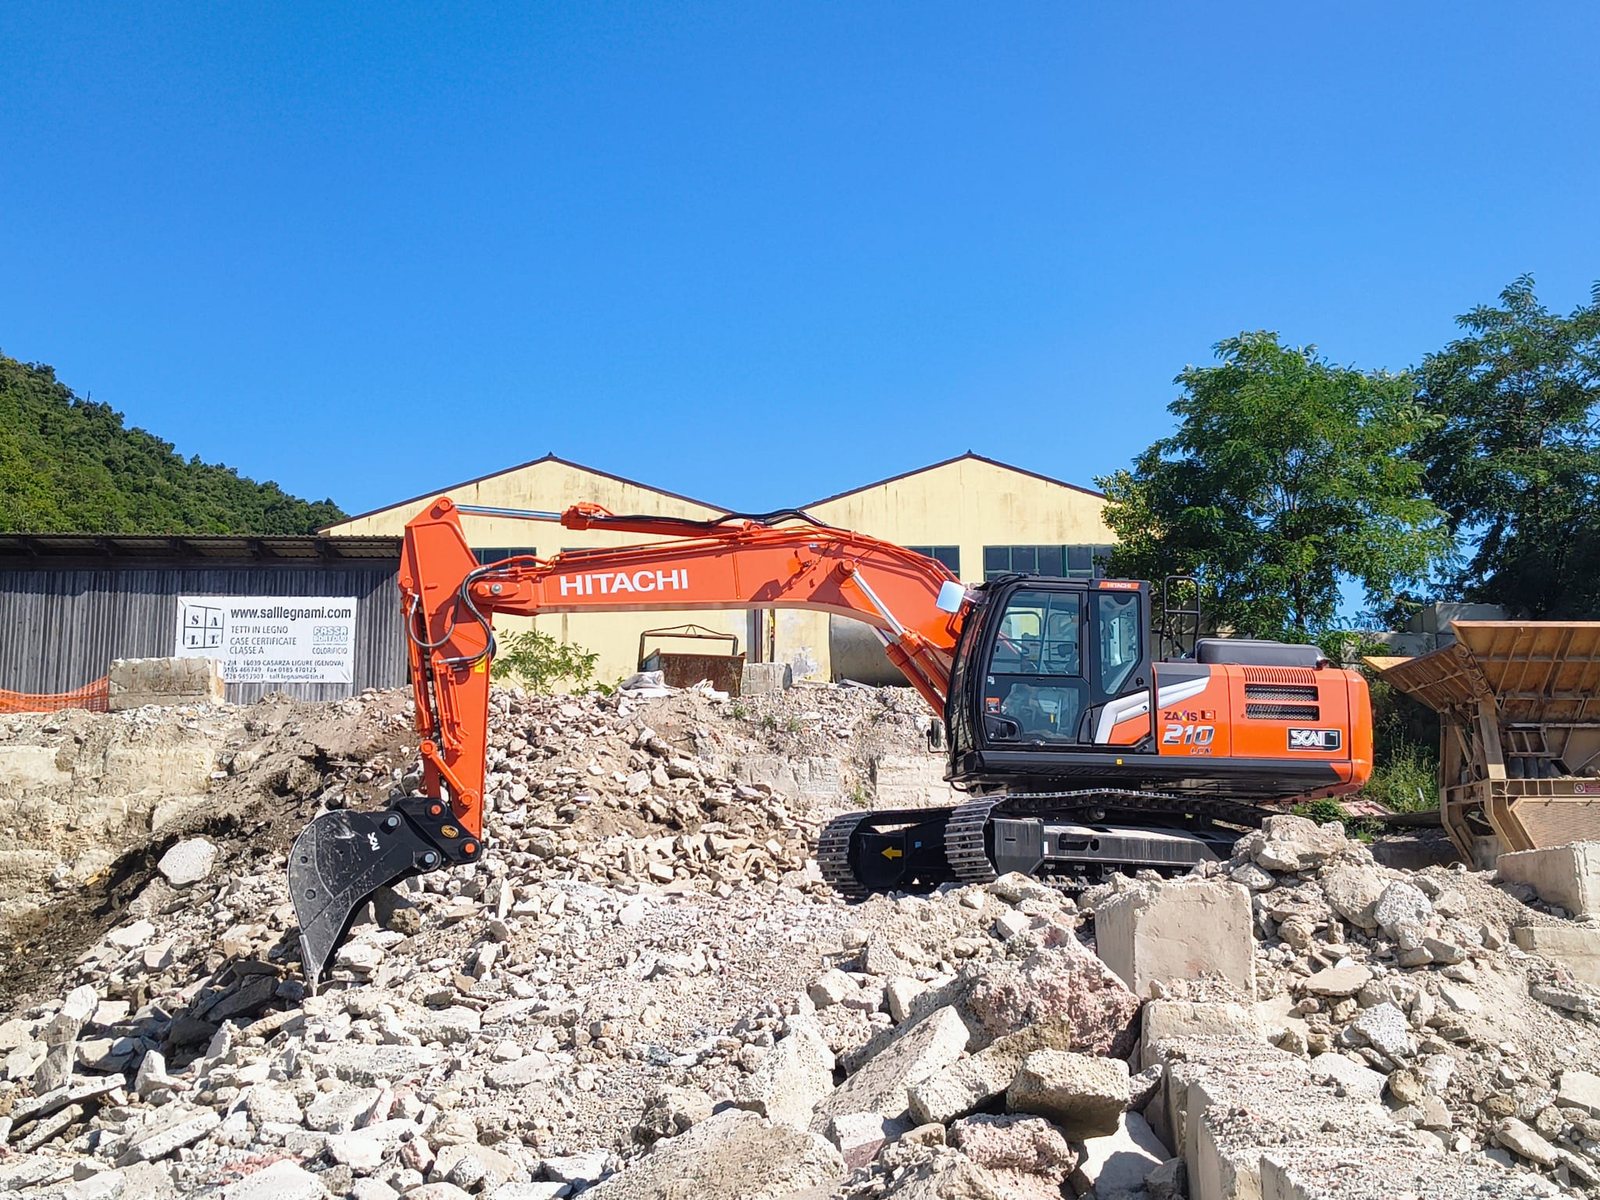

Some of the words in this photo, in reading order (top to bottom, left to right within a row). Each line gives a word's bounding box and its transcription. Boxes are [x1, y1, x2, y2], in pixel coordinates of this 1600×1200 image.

[560, 569, 689, 596] HITACHI
[230, 606, 352, 621] www.salllegnami.com
[231, 625, 251, 634] TETTI
[252, 625, 261, 634] IN
[262, 625, 289, 634] LEGNO
[230, 637, 249, 646] CASE
[251, 637, 297, 647] CERTIFICATE
[229, 646, 257, 655] CLASSE
[258, 646, 265, 655] A
[314, 660, 344, 668] (GENOVA)
[1164, 710, 1198, 722] ZAXIS
[1162, 724, 1215, 746] 210
